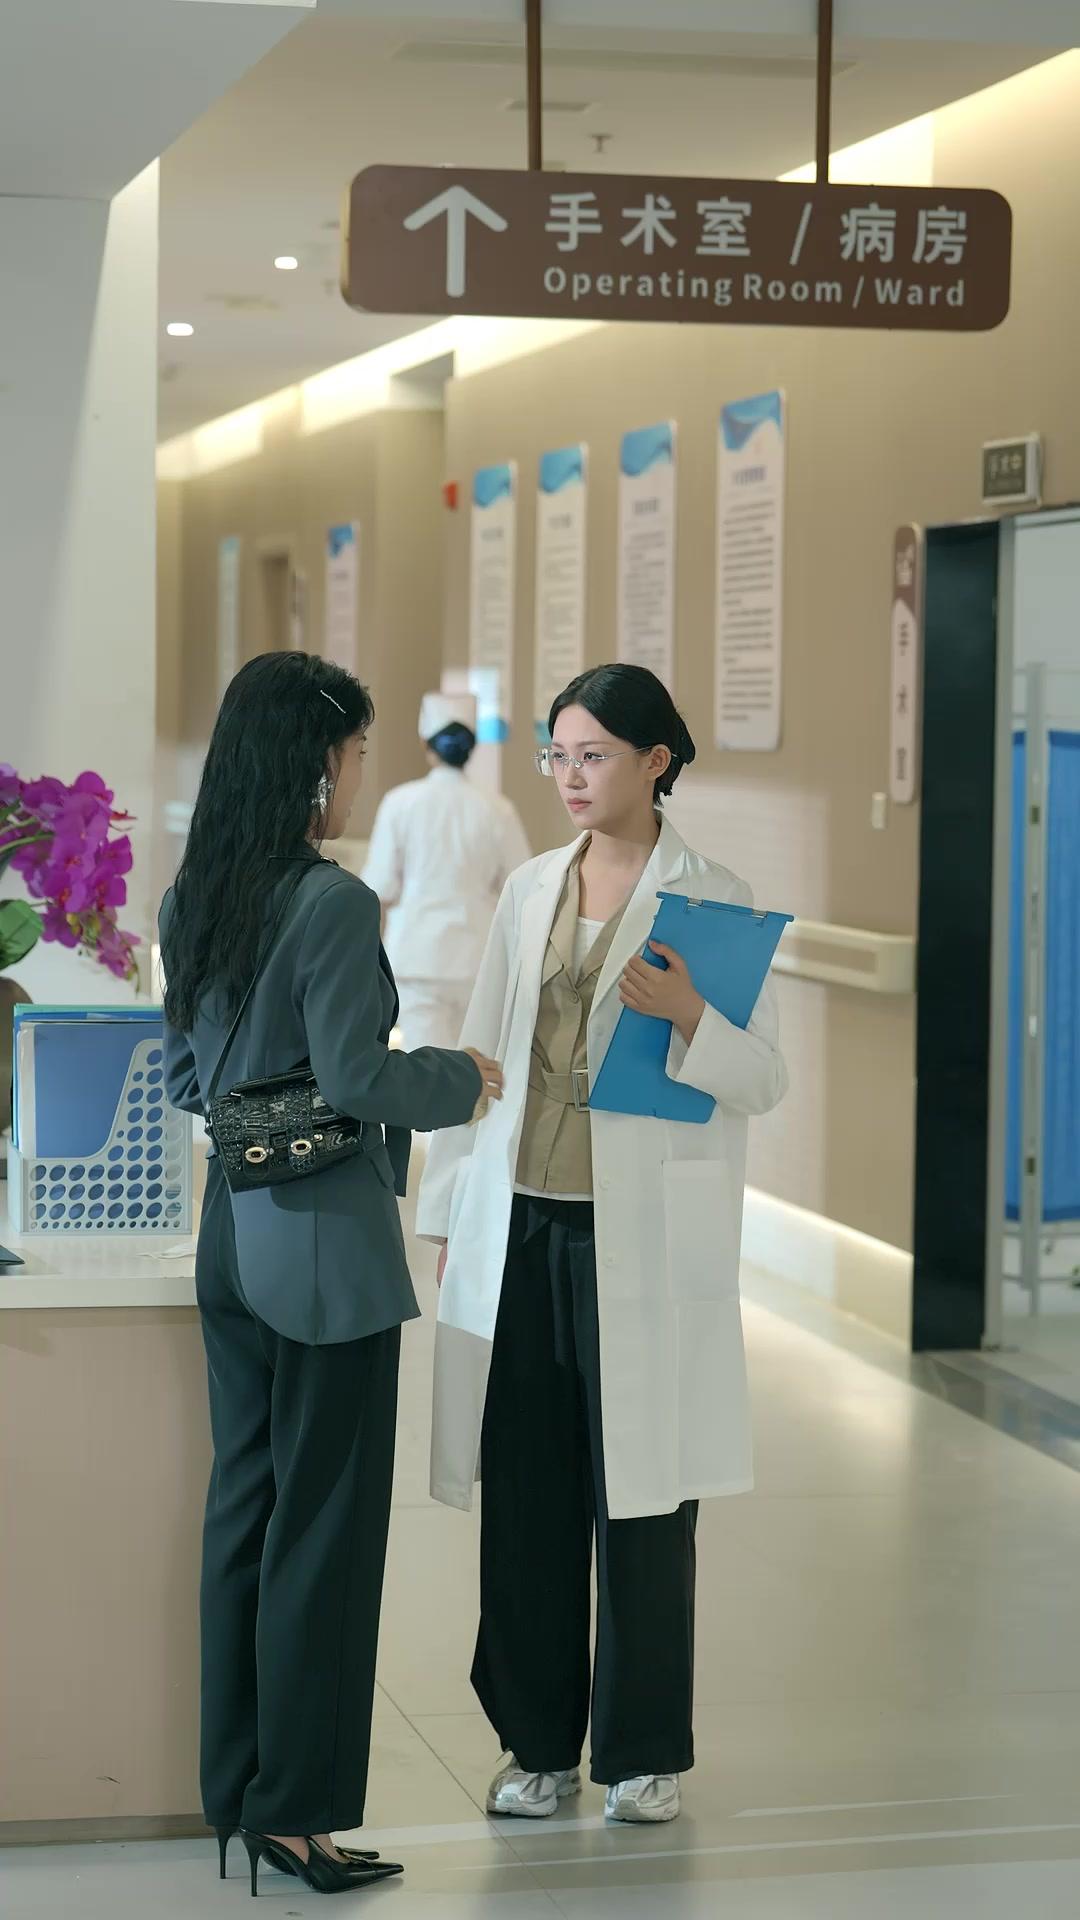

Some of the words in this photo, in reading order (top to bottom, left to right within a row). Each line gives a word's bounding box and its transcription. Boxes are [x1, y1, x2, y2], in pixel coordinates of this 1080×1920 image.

[544, 191, 752, 257] 手术室
[838, 203, 968, 265] 病房
[543, 266, 733, 308] Operating
[743, 273, 843, 303] Room
[875, 278, 965, 307] Ward
